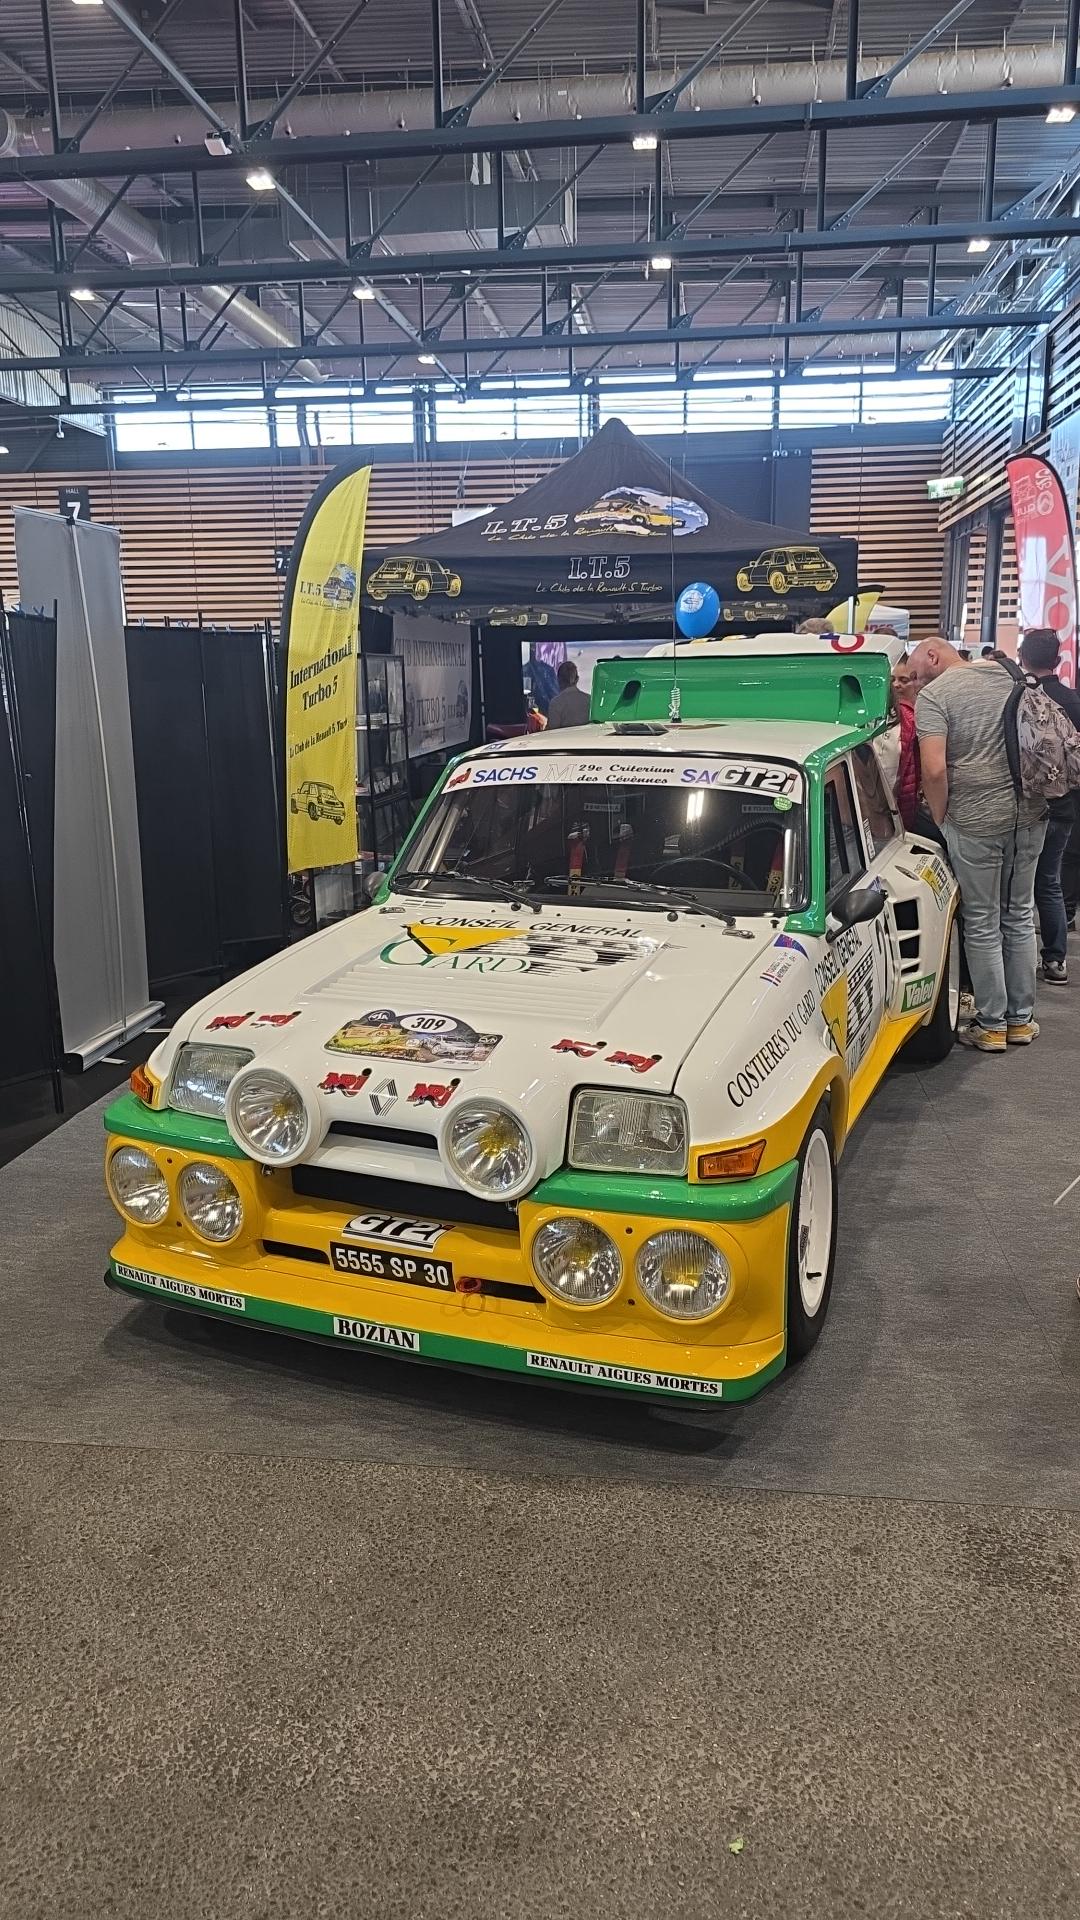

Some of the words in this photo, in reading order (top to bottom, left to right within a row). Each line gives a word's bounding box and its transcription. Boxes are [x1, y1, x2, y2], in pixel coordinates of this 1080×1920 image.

[67, 502, 81, 520] 7
[568, 556, 631, 580] I.T.5
[536, 582, 544, 593] Le
[550, 582, 571, 593] Club
[572, 582, 586, 592] de
[587, 582, 594, 592] la
[597, 582, 627, 593] Renault
[628, 582, 639, 592] 5
[640, 582, 663, 592] Turbo
[413, 640, 467, 667] INTERNATIONAL
[302, 683, 332, 712] Turbo
[332, 675, 339, 696] 5
[416, 696, 440, 727] TURBO
[332, 722, 336, 735] 5
[472, 766, 539, 783] SACHS
[576, 774, 598, 782] des
[578, 763, 602, 772] 29e
[609, 763, 675, 774] Criterium
[717, 764, 798, 795] GT2i
[419, 916, 520, 929] CONSEIL
[529, 922, 645, 938] GENERAL
[379, 936, 532, 974] GARD
[904, 980, 935, 1009] Valeo
[411, 1017, 447, 1030] 309
[727, 1027, 790, 1107] COSTIERES
[783, 1012, 803, 1043] DU
[799, 989, 816, 1026] GARD
[348, 1213, 456, 1244] GT2i
[335, 1247, 385, 1275] 5555
[389, 1257, 417, 1279] SP
[423, 1263, 449, 1286] 30
[117, 1265, 158, 1286] RENAULT
[160, 1278, 197, 1296] AIGUES
[198, 1288, 243, 1308] MORTES
[337, 1318, 415, 1349] BOZIAN
[530, 1354, 594, 1376] RENAULT
[597, 1366, 652, 1385] AIGUES
[656, 1375, 718, 1395] MORTES
